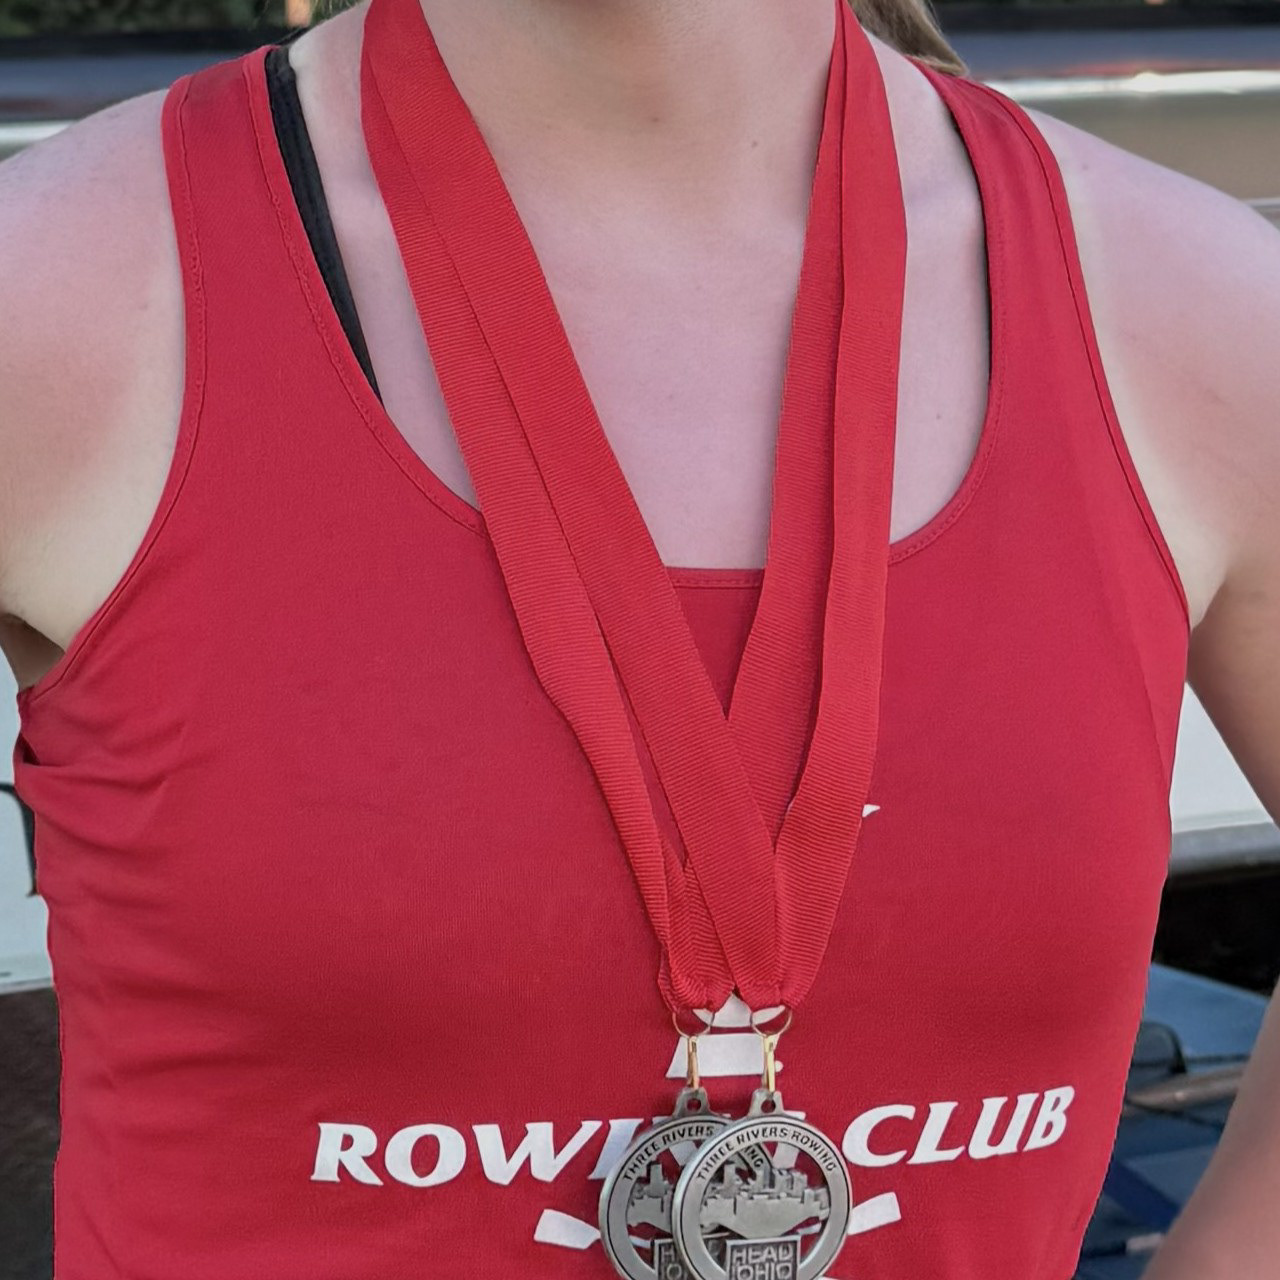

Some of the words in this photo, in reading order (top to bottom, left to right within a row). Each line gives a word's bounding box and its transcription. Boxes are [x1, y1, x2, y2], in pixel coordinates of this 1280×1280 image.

[310, 1110, 807, 1187] ROWI
[841, 1086, 1077, 1169] CLUB
[623, 1141, 661, 1181] THREE
[662, 1125, 715, 1146] RIVERS
[696, 1141, 734, 1181] THREE
[736, 1125, 789, 1146] RIVERS
[791, 1130, 837, 1172] ROWING
[732, 1243, 794, 1265] HEAD
